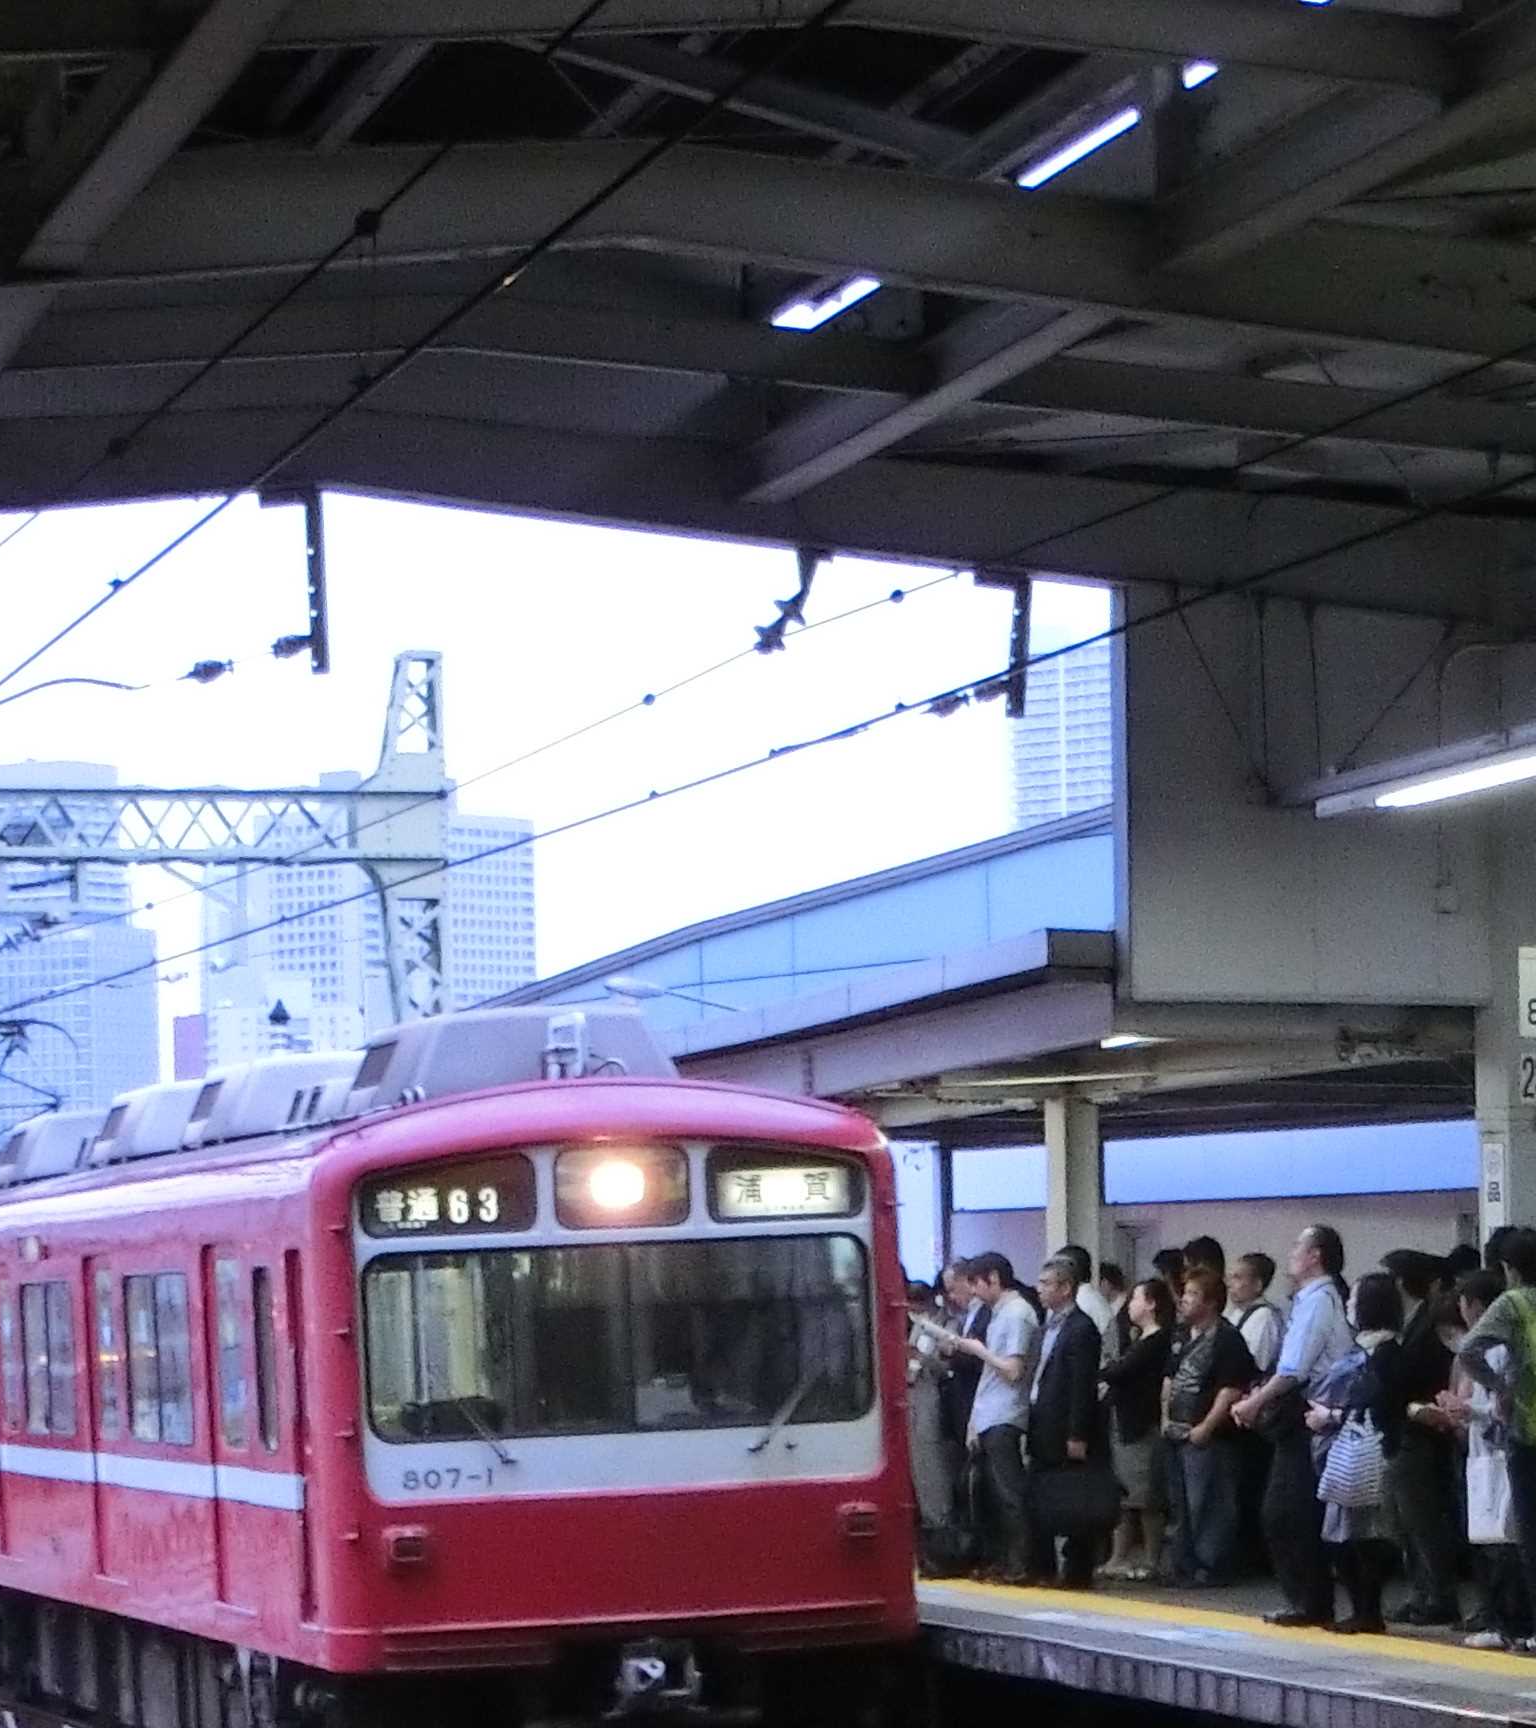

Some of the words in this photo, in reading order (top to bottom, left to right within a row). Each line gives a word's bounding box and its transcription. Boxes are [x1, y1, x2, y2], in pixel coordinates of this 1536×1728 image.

[374, 1186, 440, 1223] 普通
[447, 1186, 499, 1225] 63
[402, 1466, 494, 1491] 807-1
